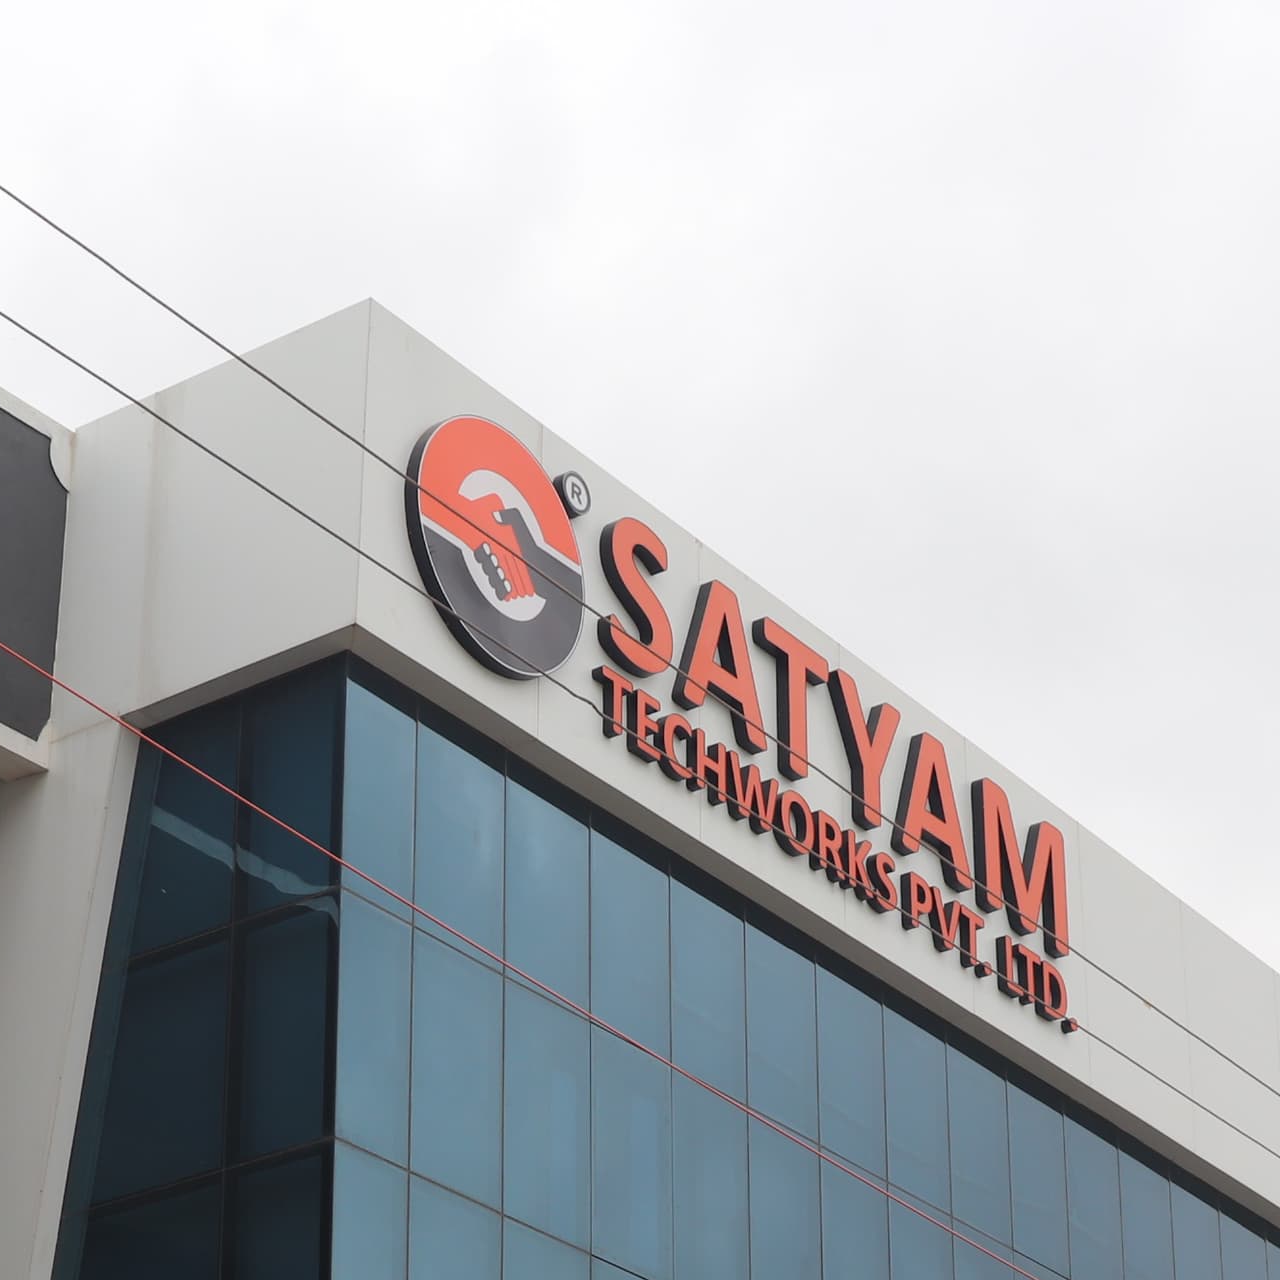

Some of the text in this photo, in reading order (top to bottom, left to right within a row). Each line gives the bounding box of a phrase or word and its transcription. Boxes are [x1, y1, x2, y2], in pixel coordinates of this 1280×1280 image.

[592, 665, 1079, 1034] TECHWORKS PVT. LTD.
[597, 517, 1070, 958] SATYAM
